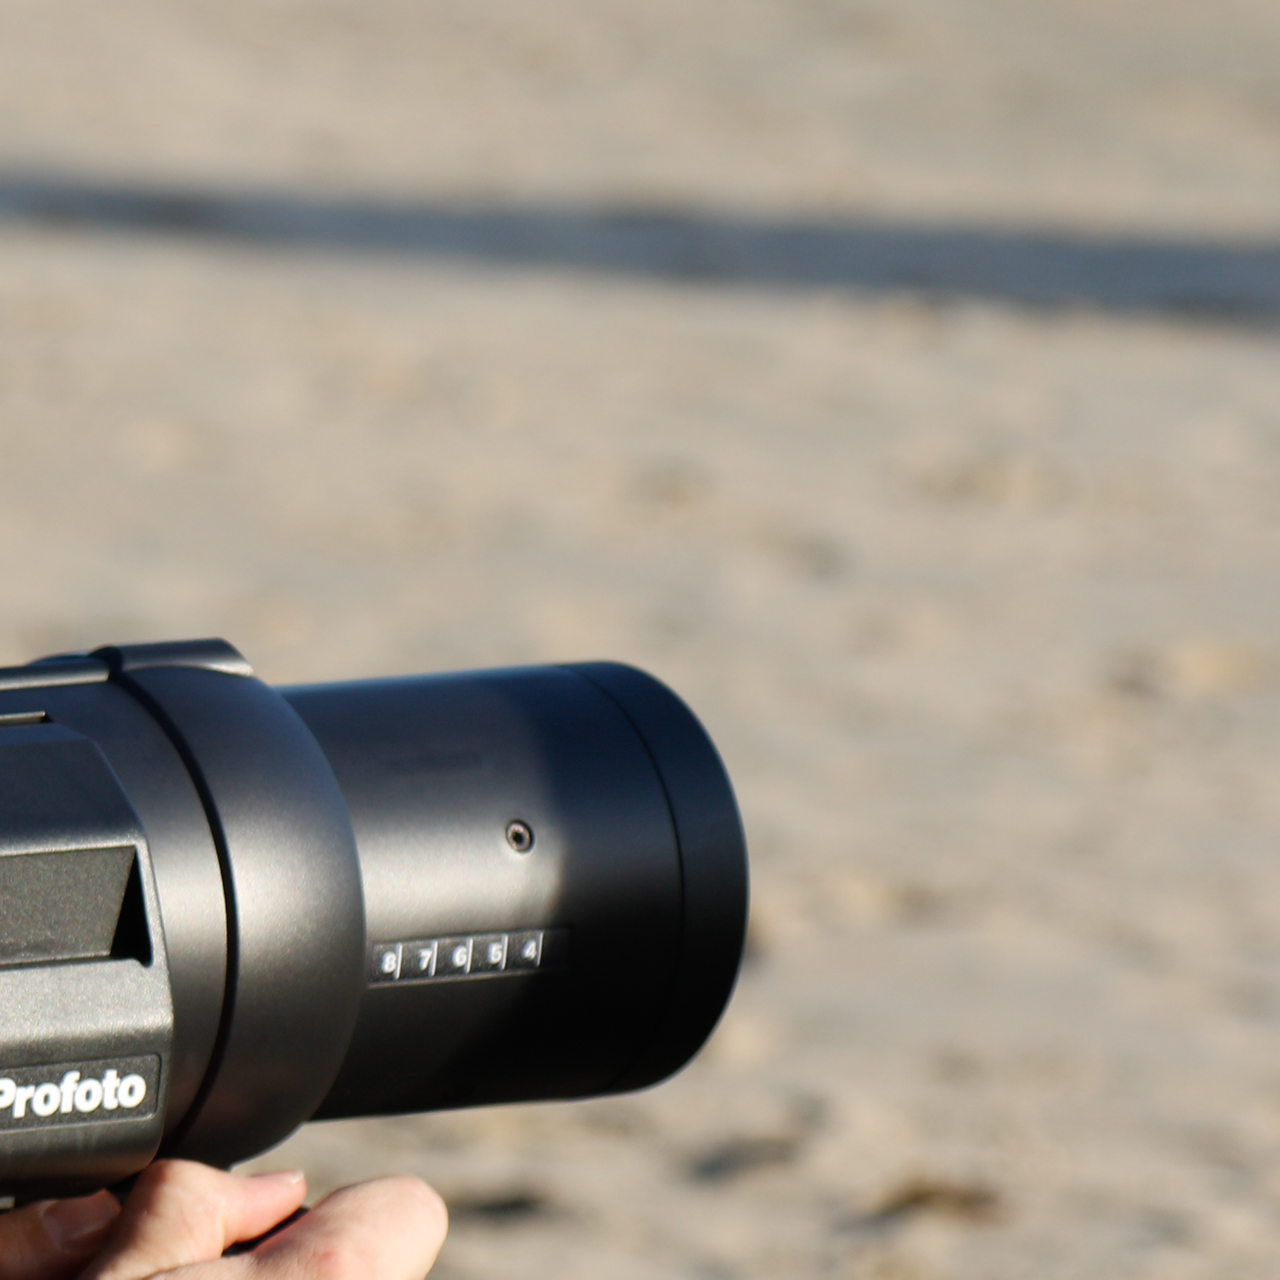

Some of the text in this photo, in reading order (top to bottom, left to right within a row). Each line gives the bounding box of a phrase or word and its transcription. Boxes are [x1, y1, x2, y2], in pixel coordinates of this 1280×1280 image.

[381, 939, 537, 974] 8 7 6 5 4
